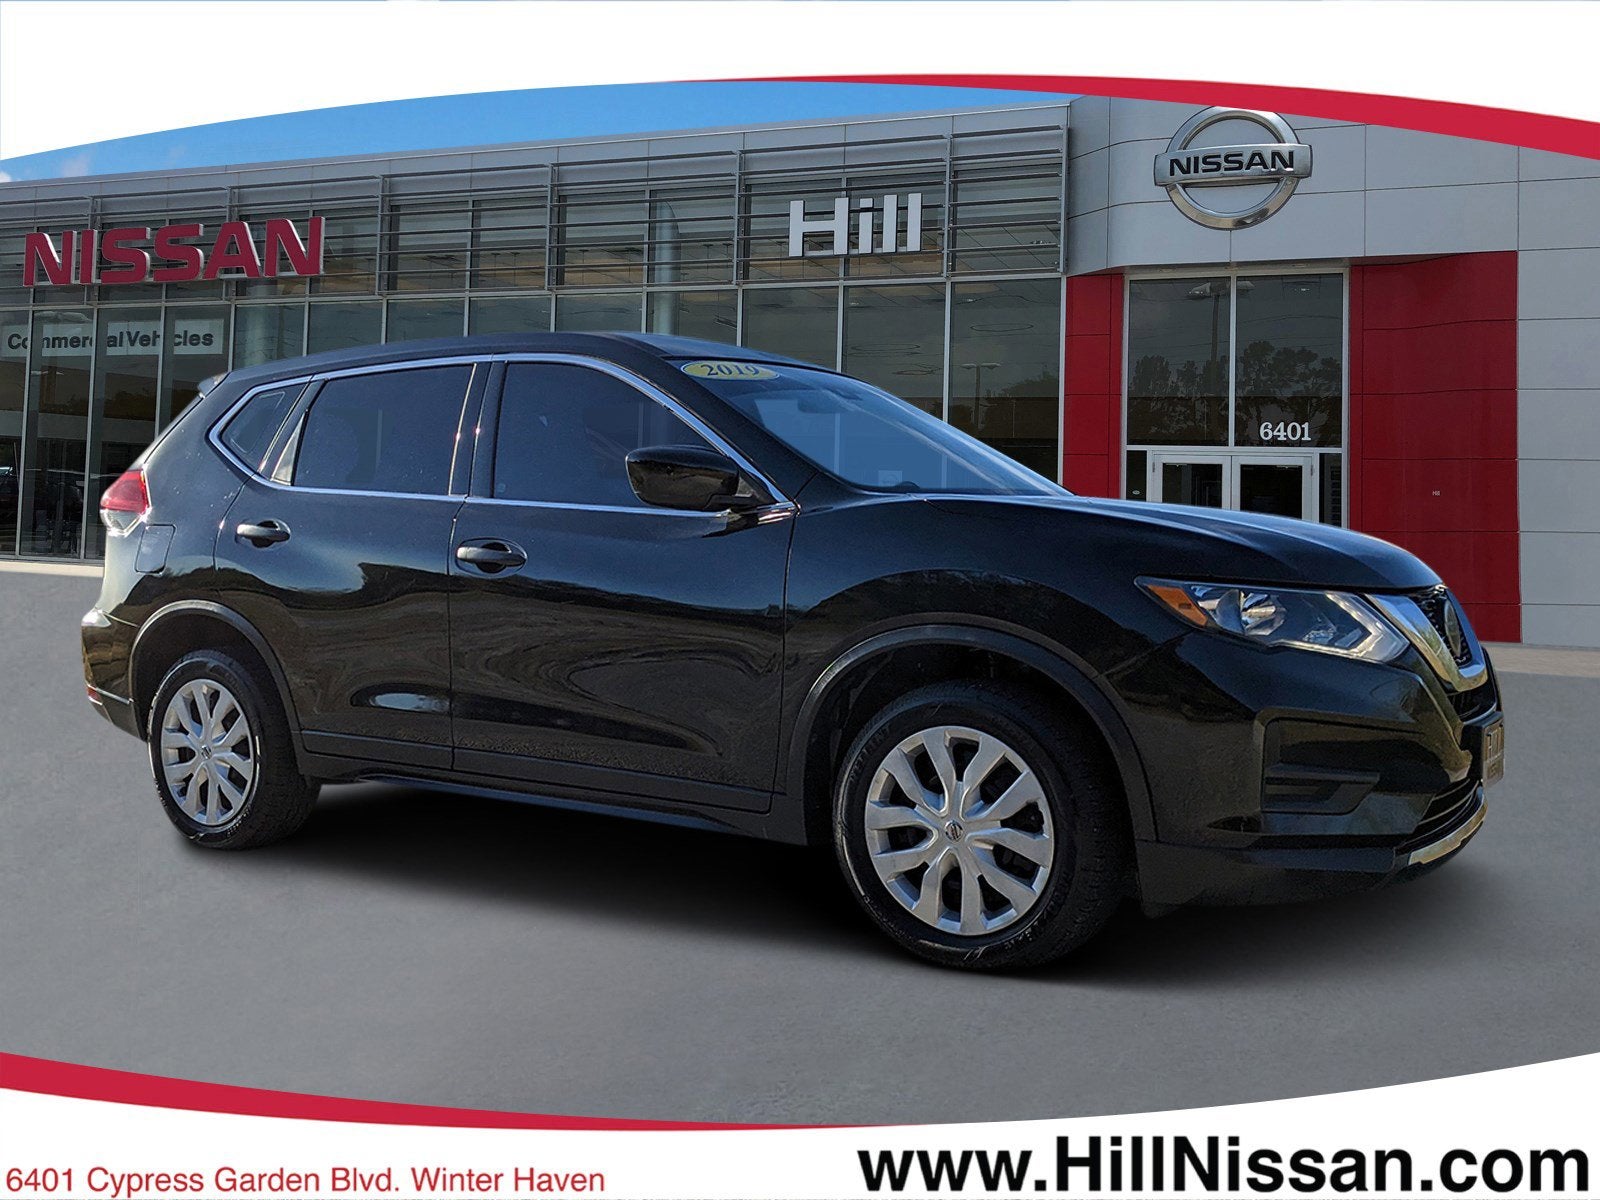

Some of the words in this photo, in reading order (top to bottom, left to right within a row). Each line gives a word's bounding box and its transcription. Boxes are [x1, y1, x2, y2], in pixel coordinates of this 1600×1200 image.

[1169, 150, 1294, 177] NISSAN
[788, 192, 923, 257] Hill
[22, 216, 326, 288] NISSAN
[126, 330, 214, 347] Vehcles
[700, 364, 760, 376] 2019
[1259, 421, 1312, 441] 6401
